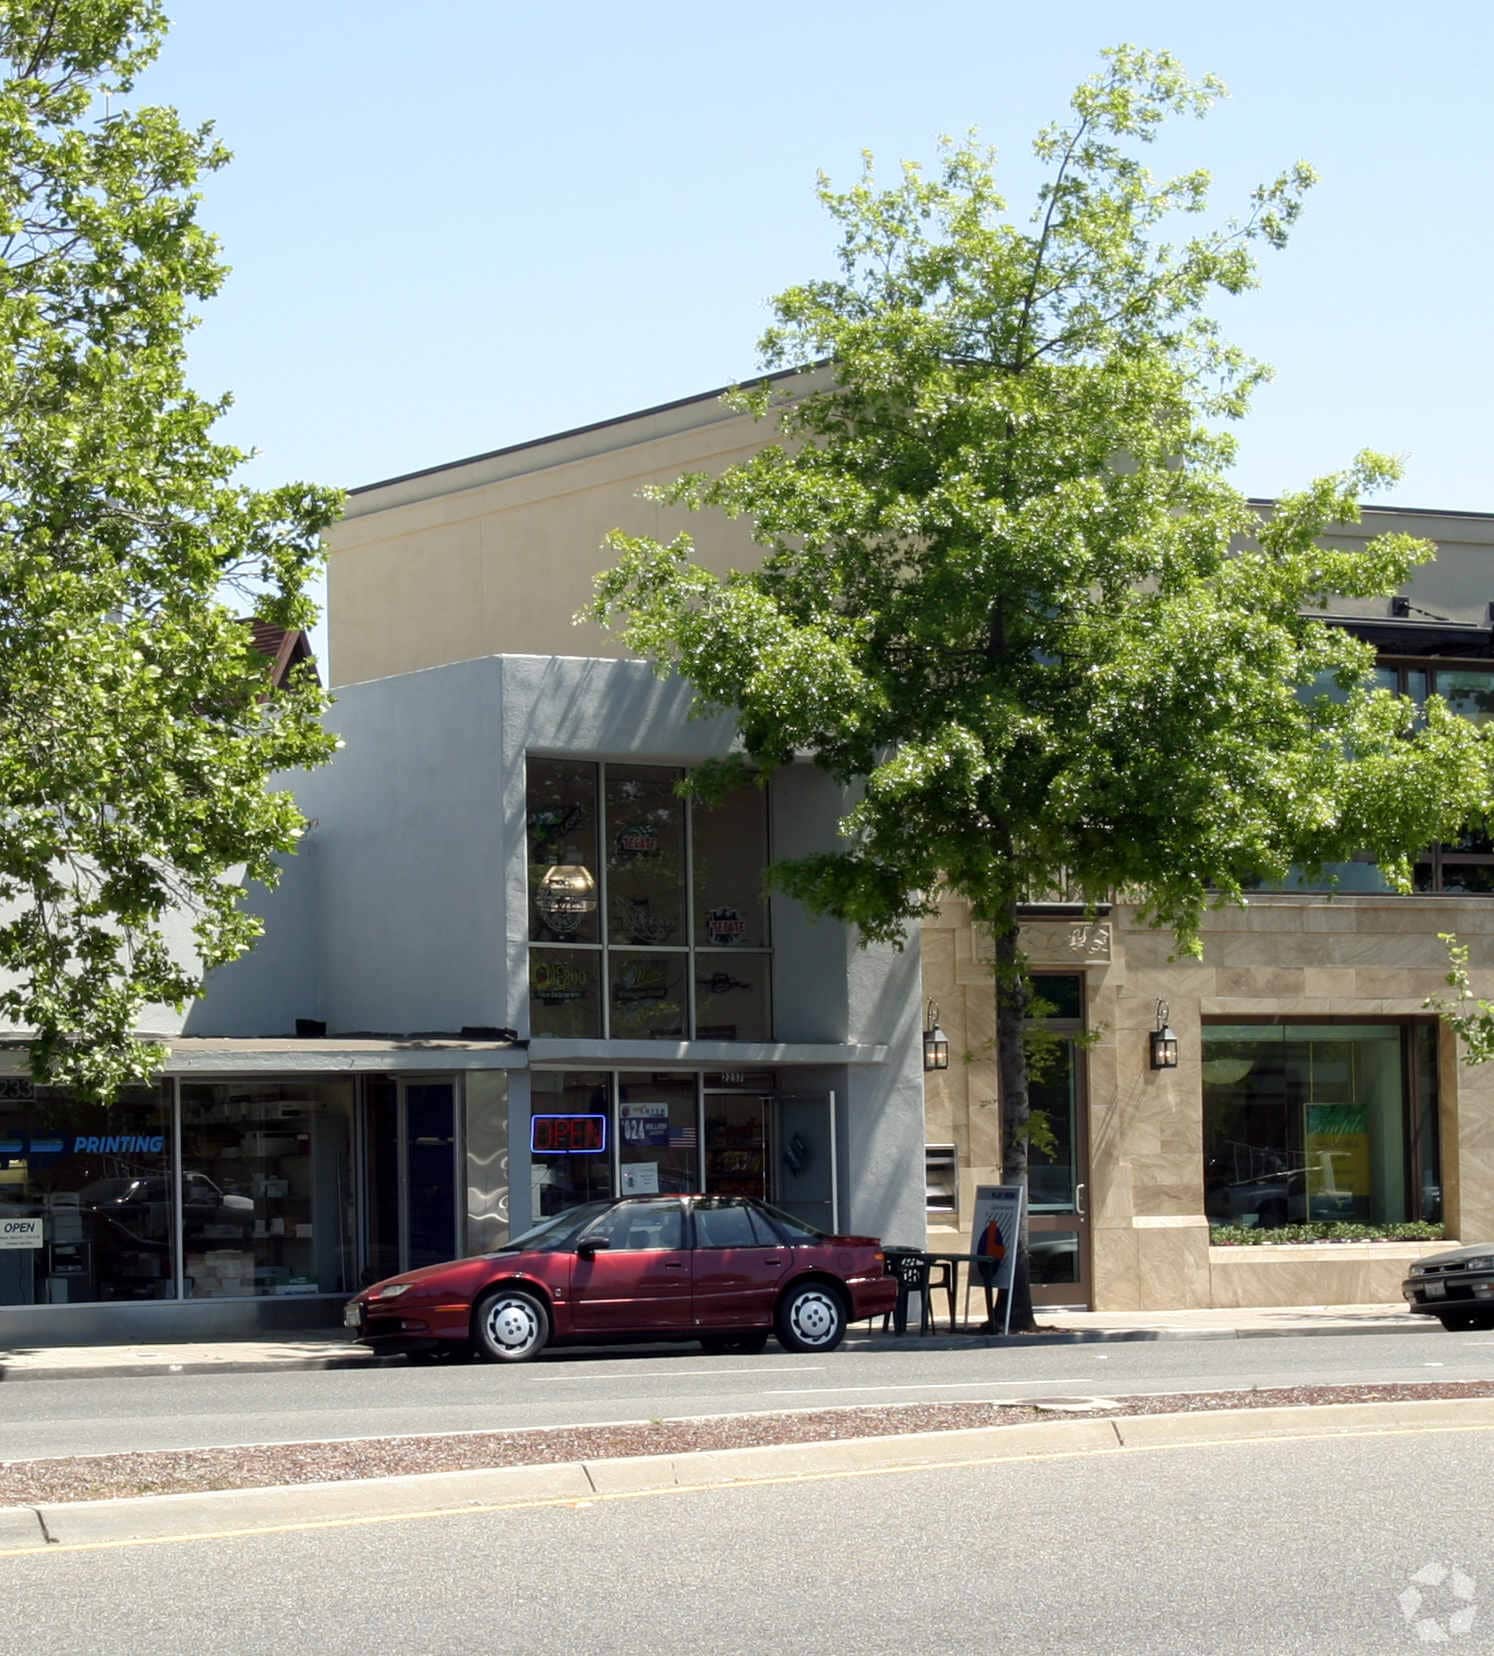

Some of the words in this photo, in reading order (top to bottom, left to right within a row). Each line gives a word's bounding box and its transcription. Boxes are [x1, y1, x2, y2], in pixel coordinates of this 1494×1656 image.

[535, 1118, 602, 1148] OPEN
[74, 1136, 165, 1152] PRINTING
[4, 1222, 35, 1233] OPEN
